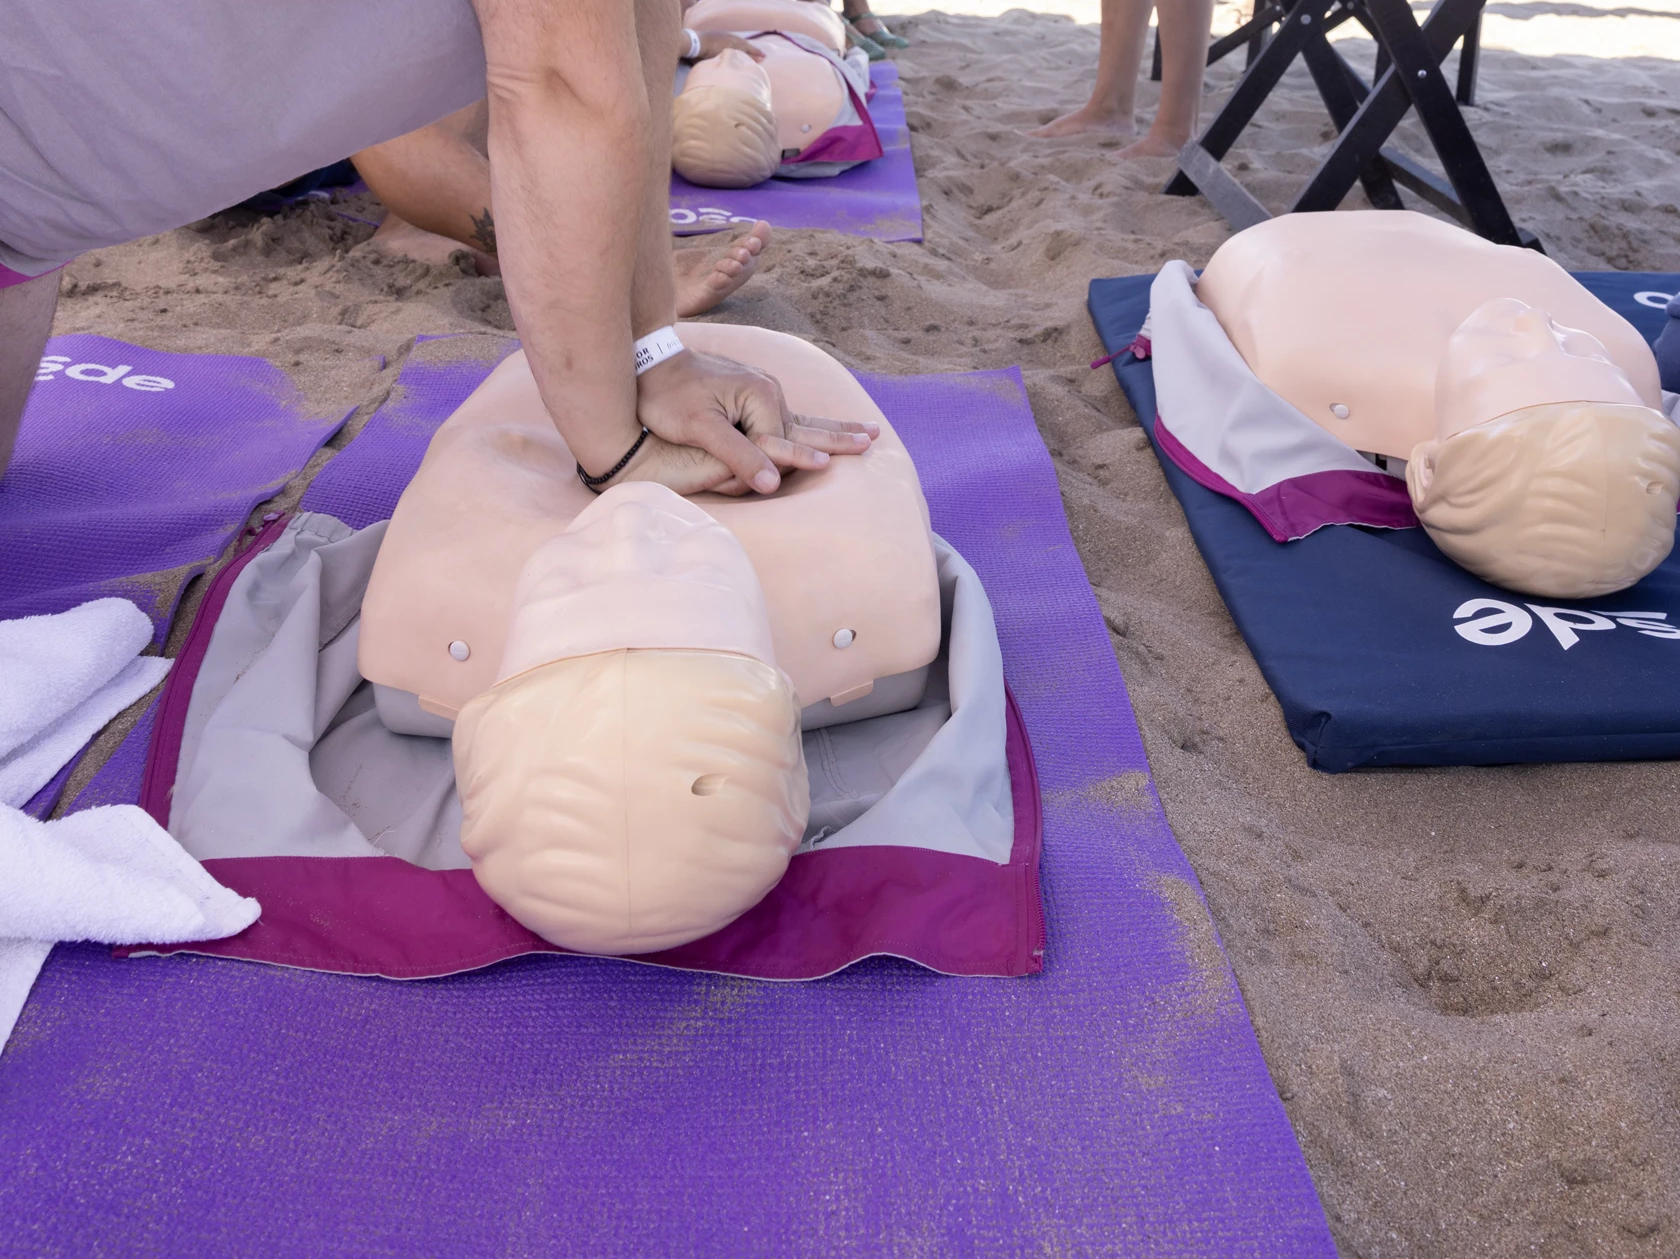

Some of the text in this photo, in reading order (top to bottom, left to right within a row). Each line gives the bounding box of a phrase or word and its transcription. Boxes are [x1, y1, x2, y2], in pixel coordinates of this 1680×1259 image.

[635, 347, 650, 359] OR
[34, 355, 176, 392] sde
[1452, 597, 1680, 651] sde
